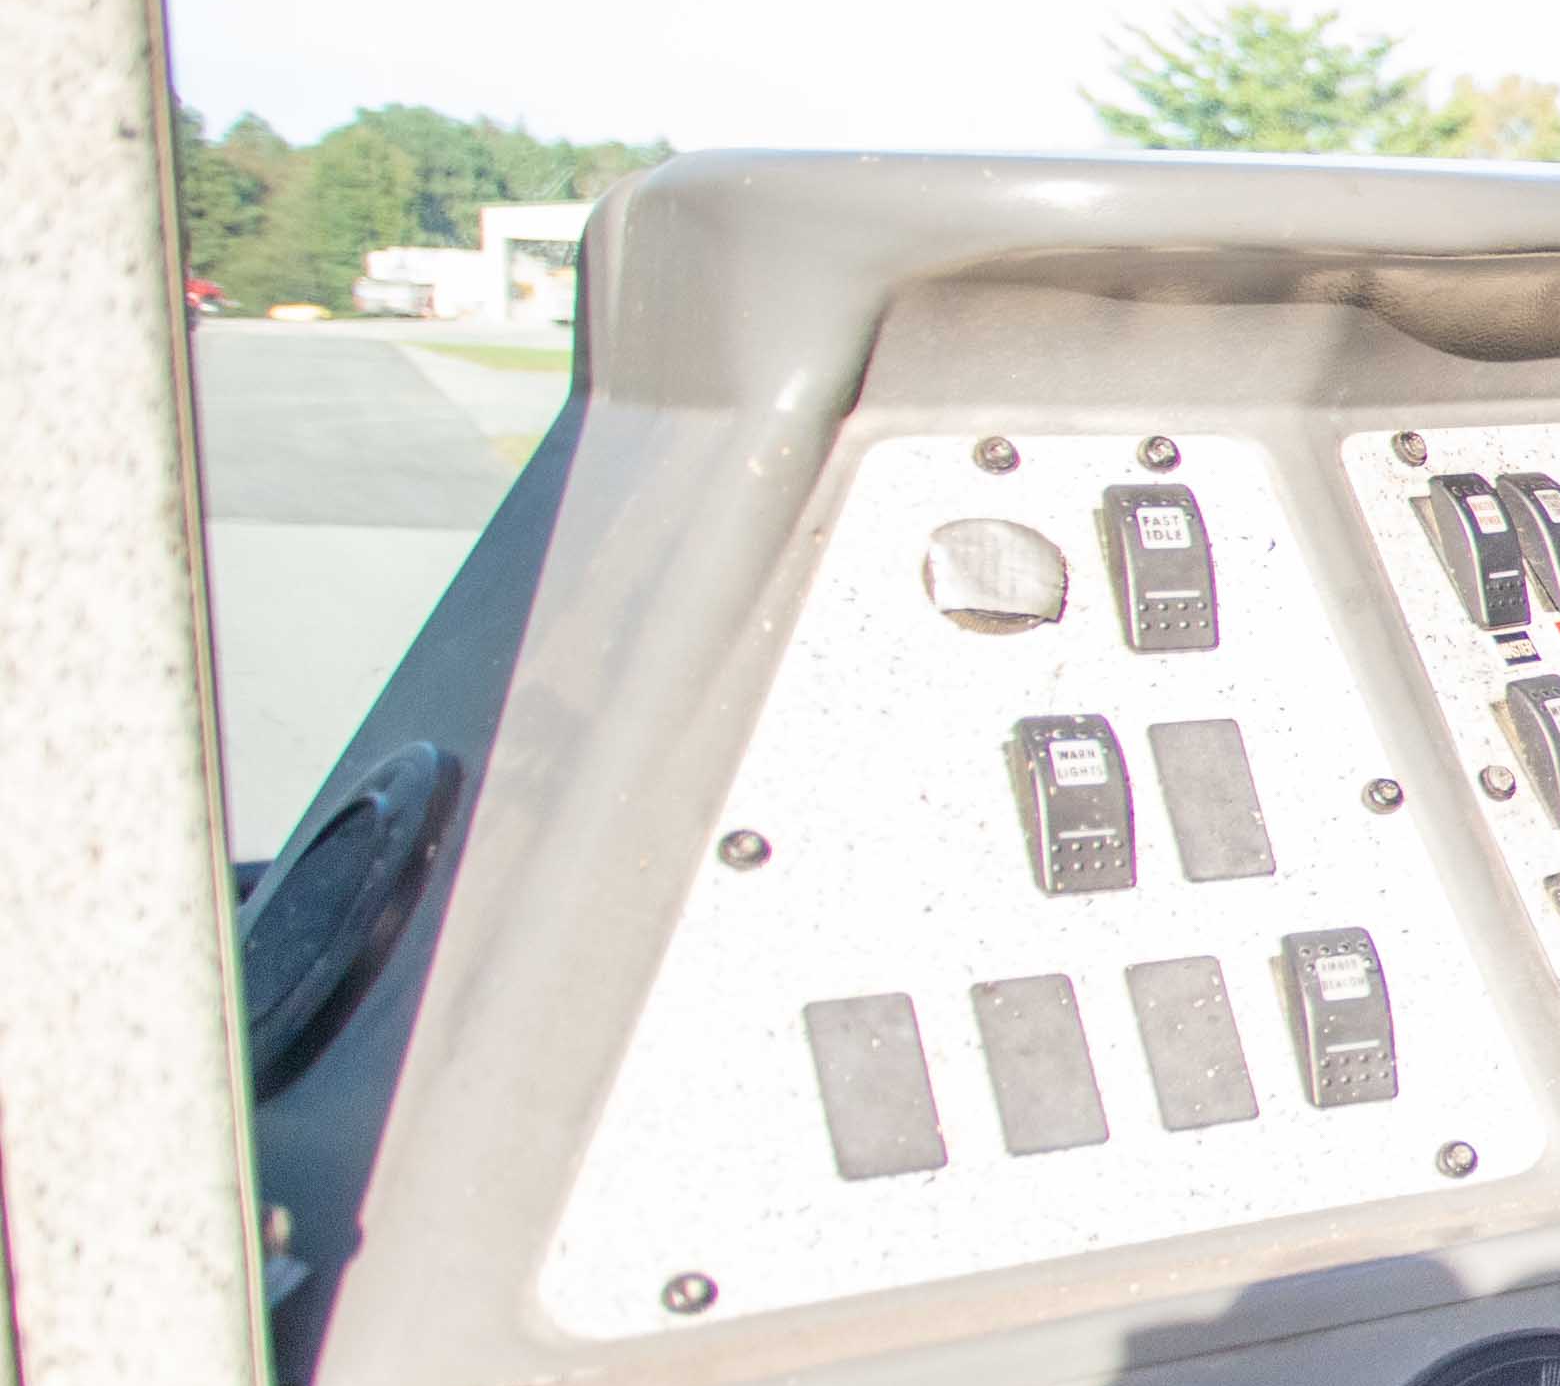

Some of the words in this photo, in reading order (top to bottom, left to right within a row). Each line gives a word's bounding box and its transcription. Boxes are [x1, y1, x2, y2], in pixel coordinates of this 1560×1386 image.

[1142, 515, 1181, 527] FAST
[1146, 529, 1183, 541] IDLE
[1058, 748, 1096, 760] WARN
[1057, 765, 1104, 778] LIGHTS
